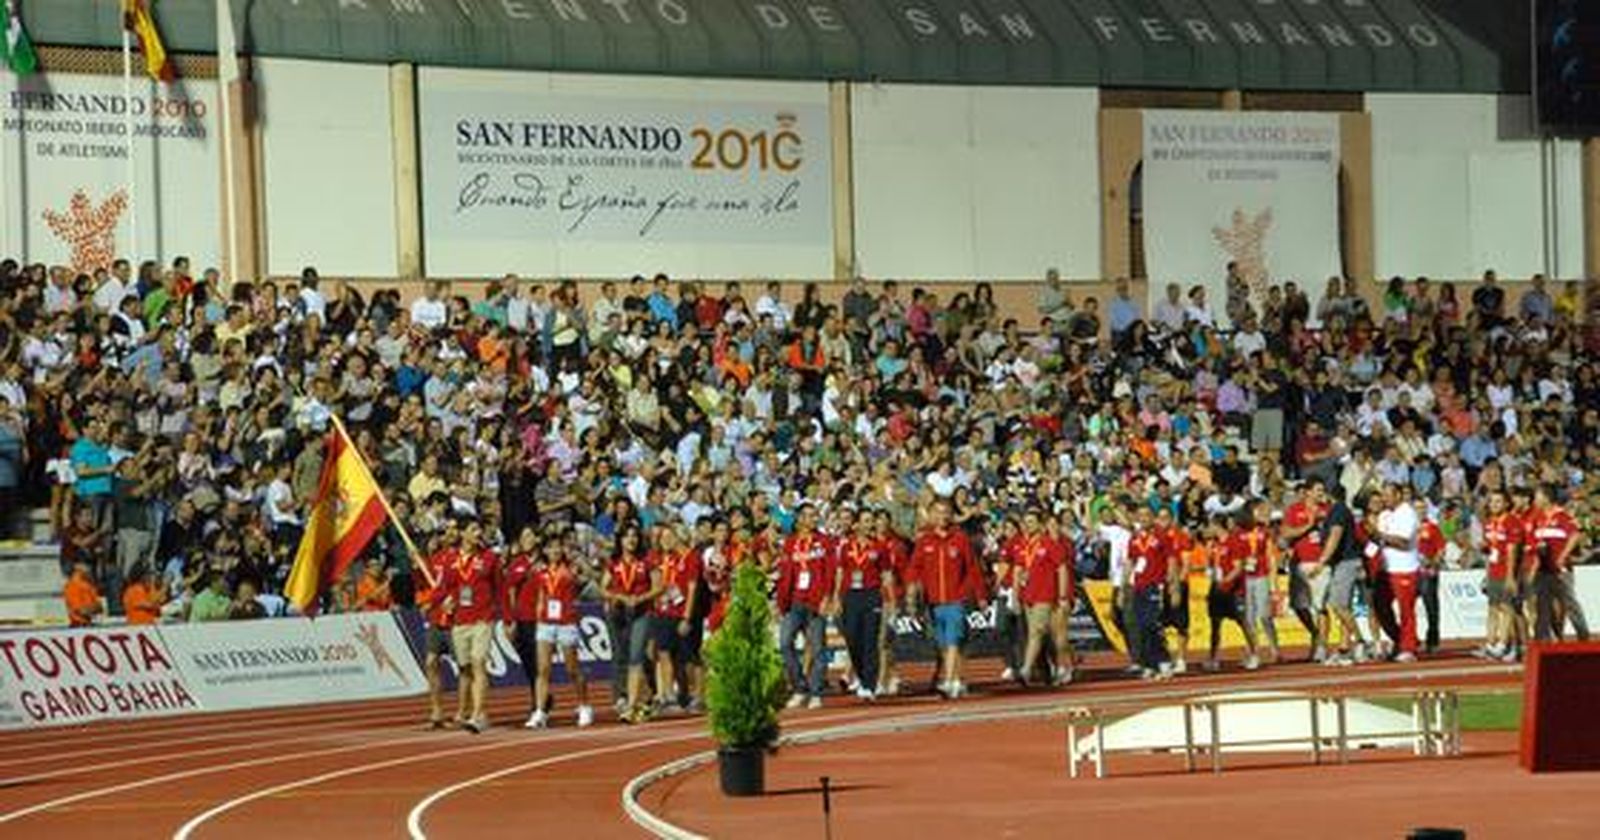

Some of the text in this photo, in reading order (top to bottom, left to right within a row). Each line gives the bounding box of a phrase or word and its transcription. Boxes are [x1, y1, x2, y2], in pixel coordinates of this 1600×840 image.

[757, 4, 844, 31] DE
[905, 8, 1034, 38] SAN
[1094, 16, 1439, 48] FERNANDO
[10, 91, 145, 116] FERNANDO
[37, 142, 54, 157] DE
[456, 120, 514, 148] SAN
[523, 122, 683, 153] FERNANDO
[0, 633, 171, 680] TOYOTA
[20, 684, 109, 721] GAMO
[106, 680, 196, 713] BAHIA
